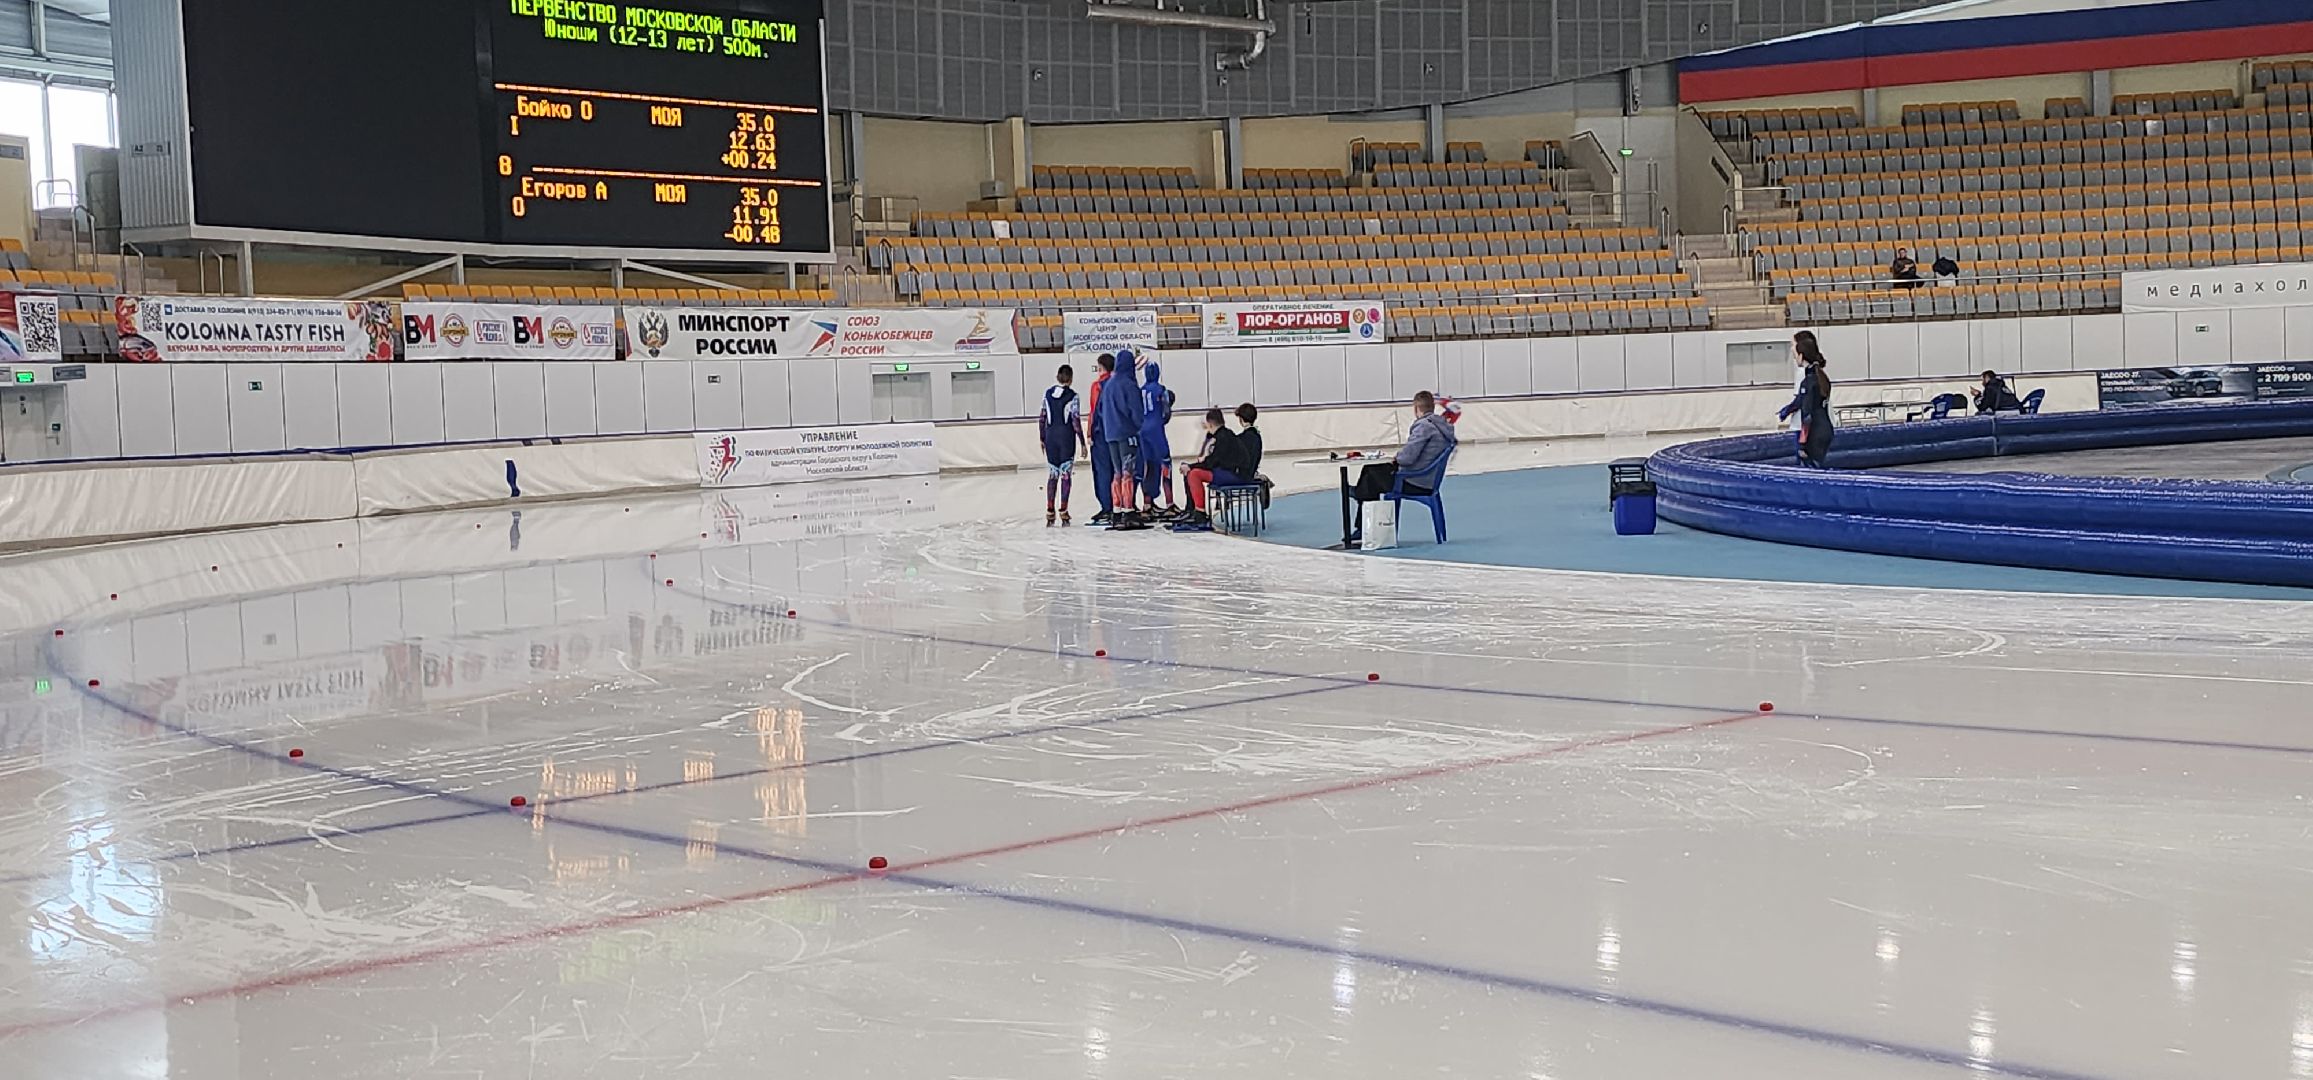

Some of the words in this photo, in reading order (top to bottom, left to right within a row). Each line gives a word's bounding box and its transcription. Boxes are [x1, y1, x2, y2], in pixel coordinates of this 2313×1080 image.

[511, 0, 617, 24] ПЕРВЕНСТВО
[625, 6, 723, 35] МОСКОВСКОЙ
[731, 18, 797, 43] ОБЛАСТИ
[544, 18, 598, 42] Юноши
[609, 25, 668, 48] (12-13
[676, 35, 714, 53] лет)
[722, 36, 769, 58] 500м.
[517, 95, 572, 119] Бойко
[651, 106, 682, 127] МОЯ
[736, 112, 775, 132] 35.0
[729, 131, 776, 151] 12.63
[721, 149, 777, 170] +00.24
[521, 177, 587, 200] Егоров
[655, 182, 686, 203] МОЯ
[740, 187, 778, 206] 35.0
[733, 206, 779, 225] 11.91
[724, 225, 781, 244] -00.48
[2147, 278, 2308, 298] медиахол
[679, 314, 790, 332] МИНСПОРТ
[847, 316, 880, 327] СОЮЗ
[1244, 312, 1343, 327] ЛОР-ОРГАНОВ
[164, 321, 253, 341] KOLOMNA
[255, 323, 303, 341] TASTY
[308, 323, 345, 342] FISH
[844, 330, 933, 341] КОНЬКОБЕЖЦЕВ
[696, 338, 777, 355] РОССИИ
[841, 345, 885, 355] РОССИИ
[800, 430, 859, 442] УПРАВЛЕНИЕ
